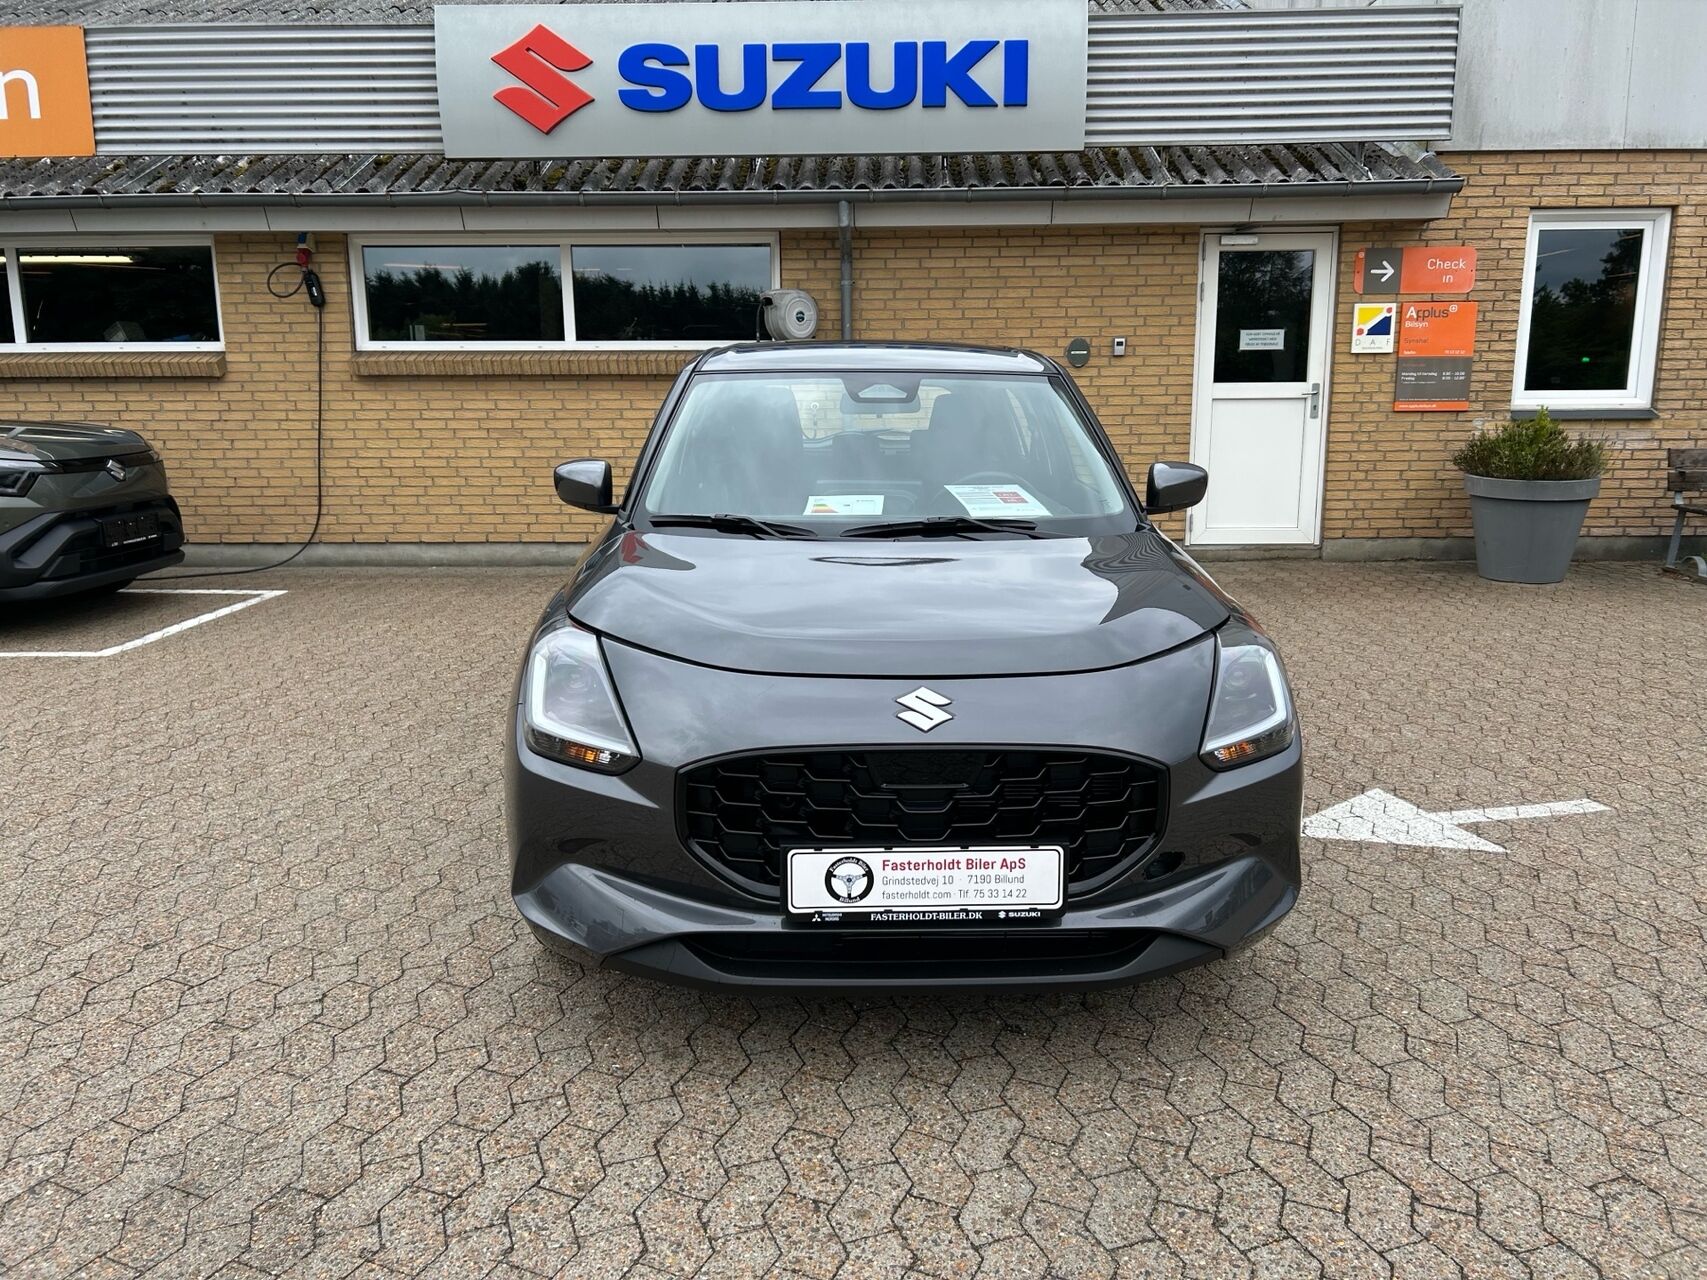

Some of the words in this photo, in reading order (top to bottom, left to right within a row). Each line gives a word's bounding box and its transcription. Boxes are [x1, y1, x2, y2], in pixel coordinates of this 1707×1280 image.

[618, 39, 1028, 112] SUZUKI
[1427, 258, 1466, 270] Check
[1442, 275, 1454, 283] in
[1405, 320, 1428, 328] Bilsyn
[882, 859, 962, 871] Fasterholdt
[966, 858, 997, 870] Biler
[1000, 858, 1026, 872] ApS
[882, 875, 939, 887] Grindstedvej
[942, 875, 954, 885] 10
[967, 874, 992, 884] 7190
[994, 874, 1025, 884] Billund
[973, 889, 985, 899] 75
[987, 889, 999, 899] 33
[1002, 889, 1013, 899] 14
[1015, 888, 1027, 898] 22
[870, 912, 982, 921] FASTERHOLDT-BILER.DK
